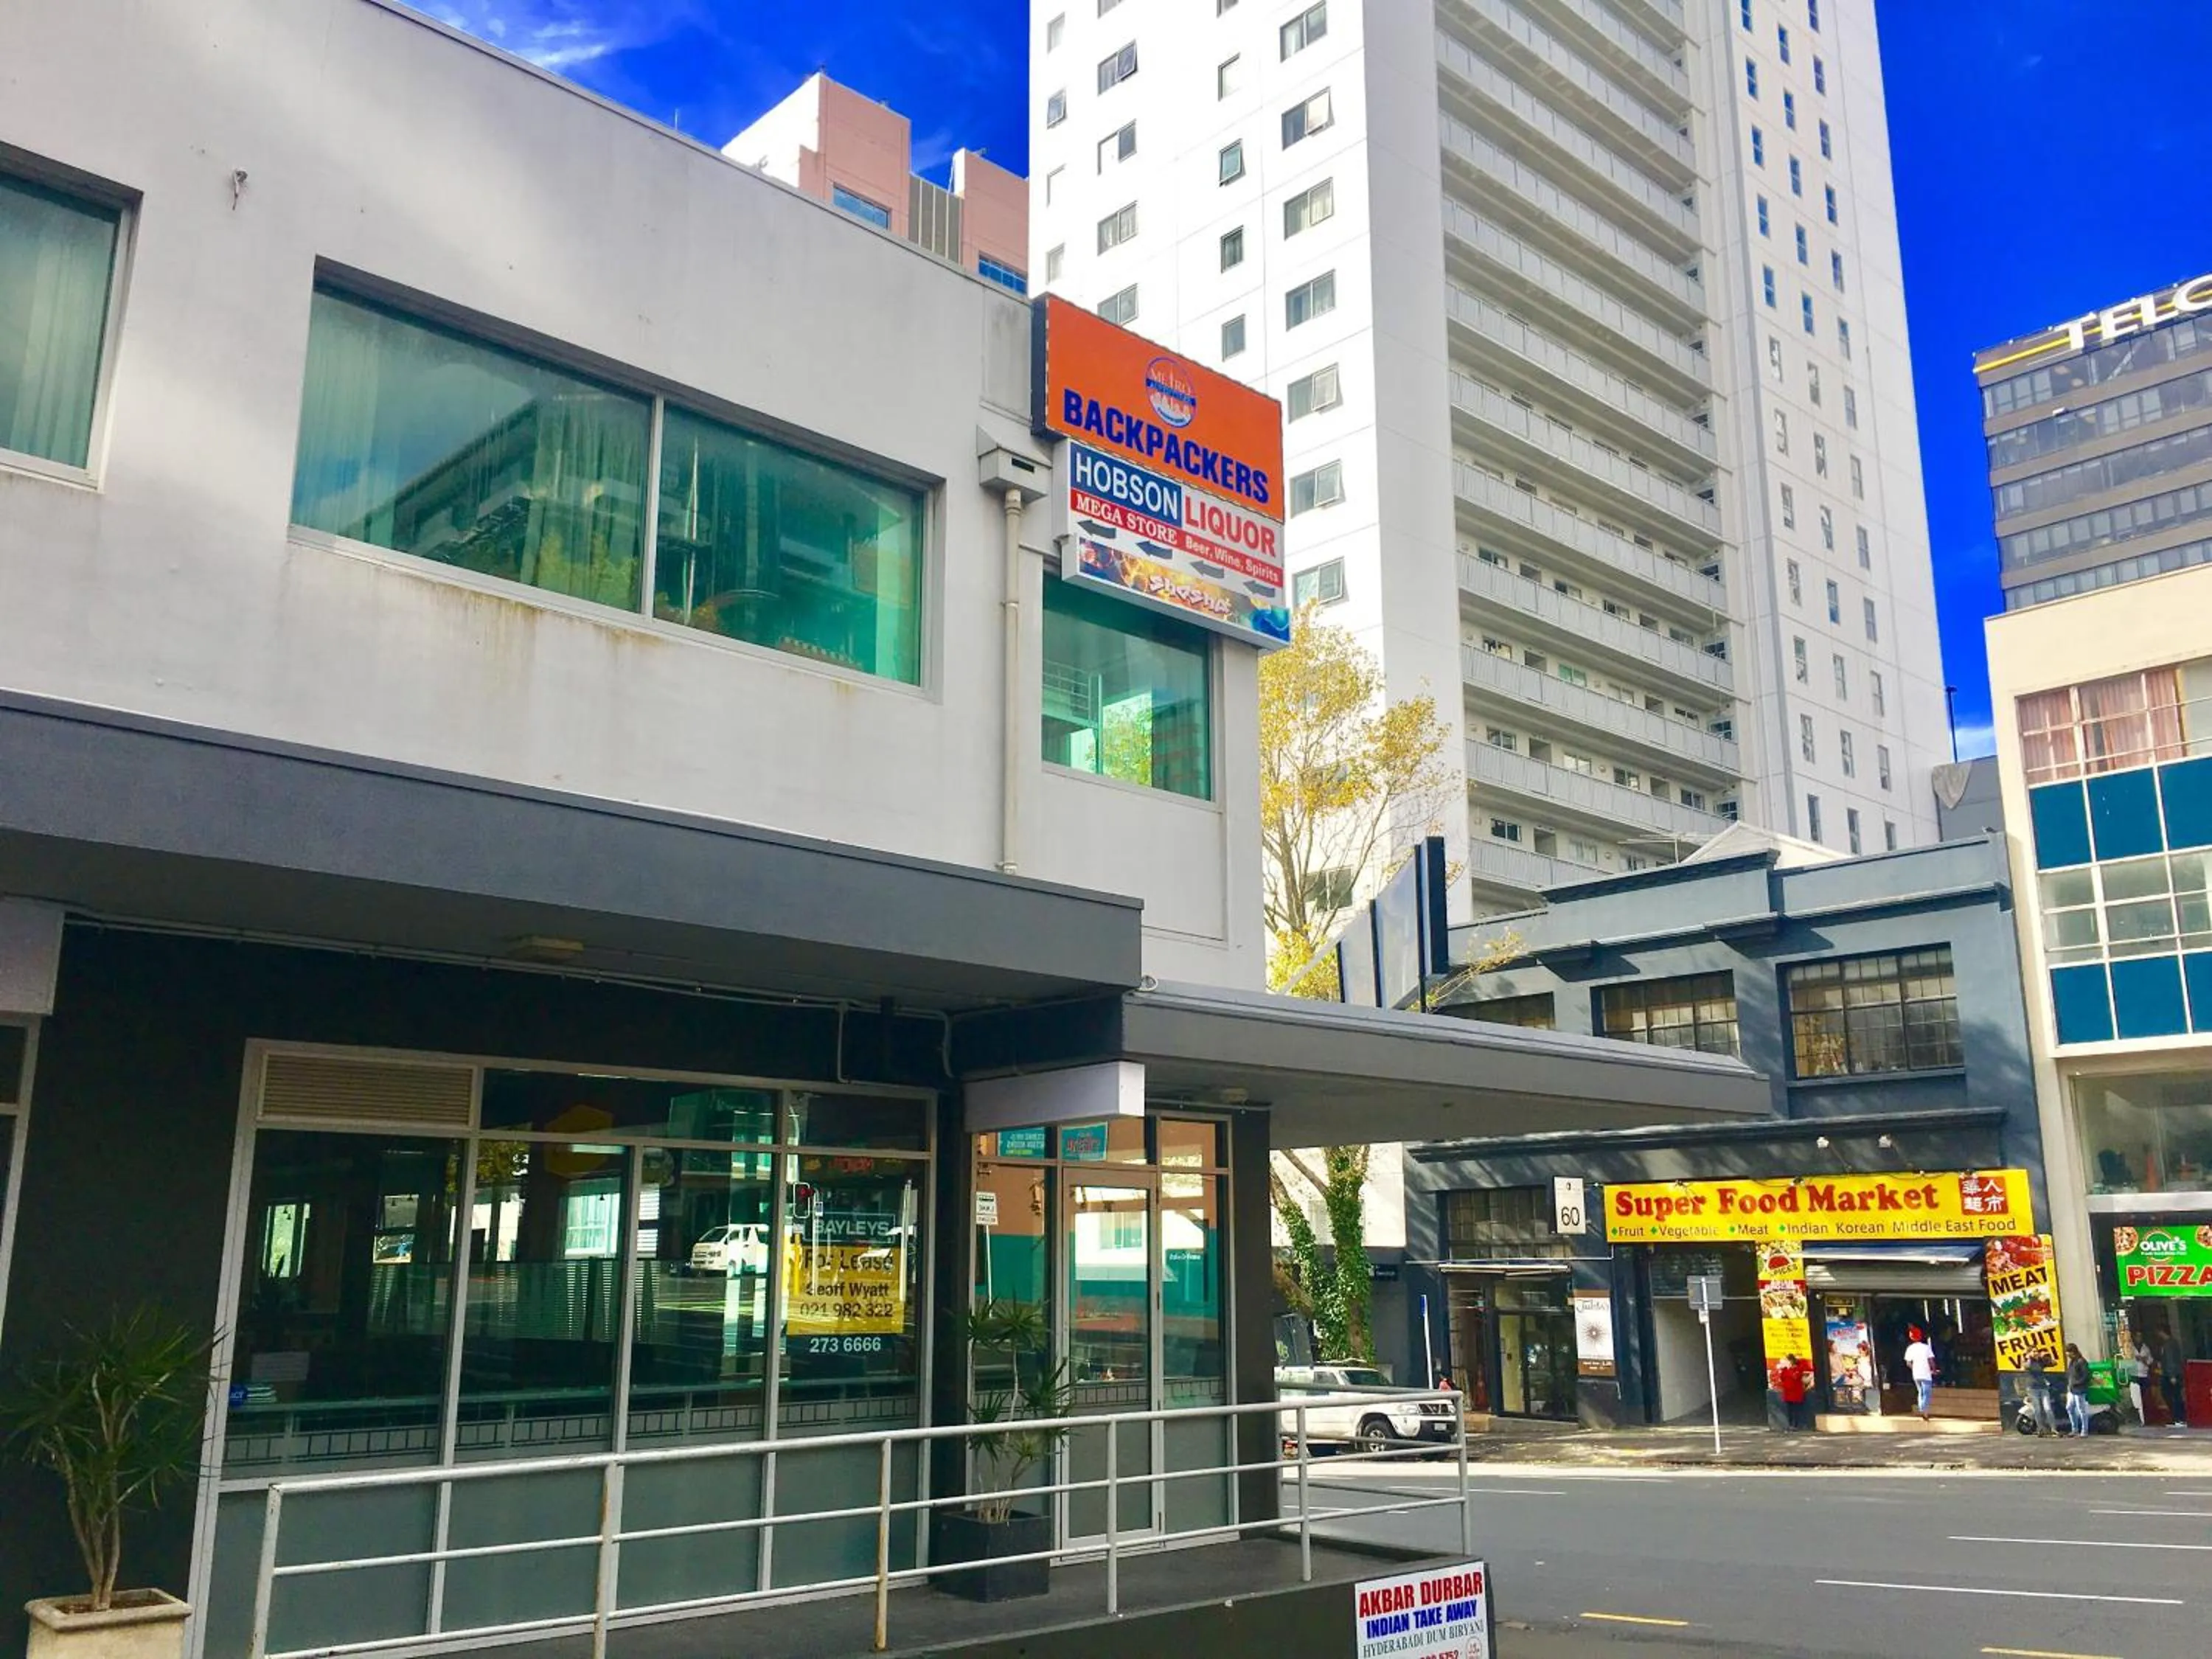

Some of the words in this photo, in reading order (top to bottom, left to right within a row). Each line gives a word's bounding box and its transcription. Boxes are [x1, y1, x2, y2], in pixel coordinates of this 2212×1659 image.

[1062, 387, 1269, 504] BACKPACKERS
[1075, 451, 1178, 521] HOBSON
[1076, 493, 1123, 527] MEGA
[1127, 512, 1178, 545] STORE
[1185, 495, 1276, 557] LIQUOR
[1245, 559, 1279, 583] Spirits
[1561, 1206, 1580, 1227] 60
[1615, 1190, 1707, 1222] Super
[1717, 1185, 1800, 1215] Food
[1806, 1182, 1939, 1213] Market
[815, 1219, 889, 1237] BAYLEYS
[1618, 1226, 1644, 1237] Fruit
[1659, 1225, 1719, 1239] Vegetable
[1737, 1223, 1769, 1236] Meat
[1787, 1221, 1829, 1234] Indian
[1836, 1219, 1885, 1234] Korean
[1892, 1219, 1941, 1233] Middle
[1946, 1219, 1974, 1232] East
[1978, 1217, 2017, 1231] Food
[2140, 1236, 2187, 1252] OLIVE'S
[1992, 1266, 2048, 1295] MEAT
[2126, 1264, 2212, 1286] PIZZA
[849, 1282, 889, 1299] Wyatt
[832, 1302, 862, 1318] 982
[809, 1337, 839, 1353] 273
[842, 1337, 882, 1353] 6666
[1997, 1327, 2056, 1356] FRUIT
[1359, 1584, 1415, 1618] AKBAR
[1419, 1571, 1483, 1605] DURBAR
[1366, 1612, 1411, 1639] INDIAN
[1413, 1606, 1442, 1628] TAKE
[1446, 1599, 1478, 1622] AWAY
[1363, 1632, 1424, 1658] HYDERABADI
[1427, 1627, 1446, 1644] DUM
[1449, 1619, 1484, 1639] BIRYANI
